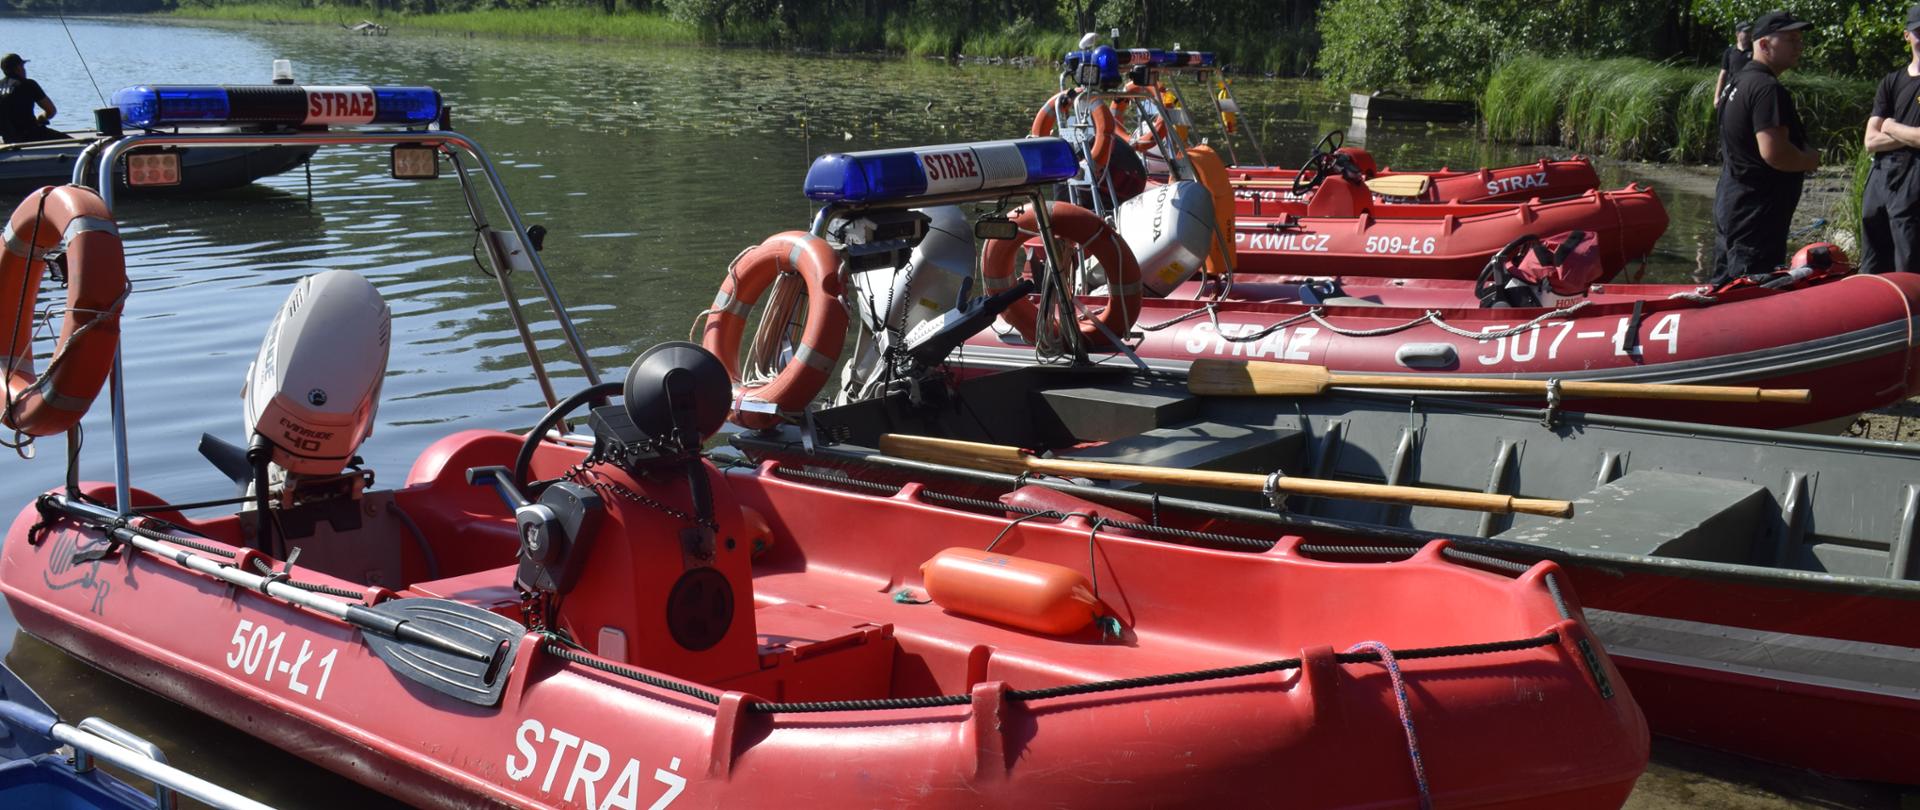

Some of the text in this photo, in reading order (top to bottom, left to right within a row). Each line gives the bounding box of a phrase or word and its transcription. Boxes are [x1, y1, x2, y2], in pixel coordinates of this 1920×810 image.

[1152, 183, 1169, 243] HONDA
[1250, 233, 1331, 252] KWILCZ
[1365, 235, 1436, 254] 509-Ł6
[279, 416, 335, 441] EVINRUDE
[284, 430, 321, 452] 40
[226, 619, 338, 701] 501-Ł1
[505, 718, 687, 810] STRAŻ
